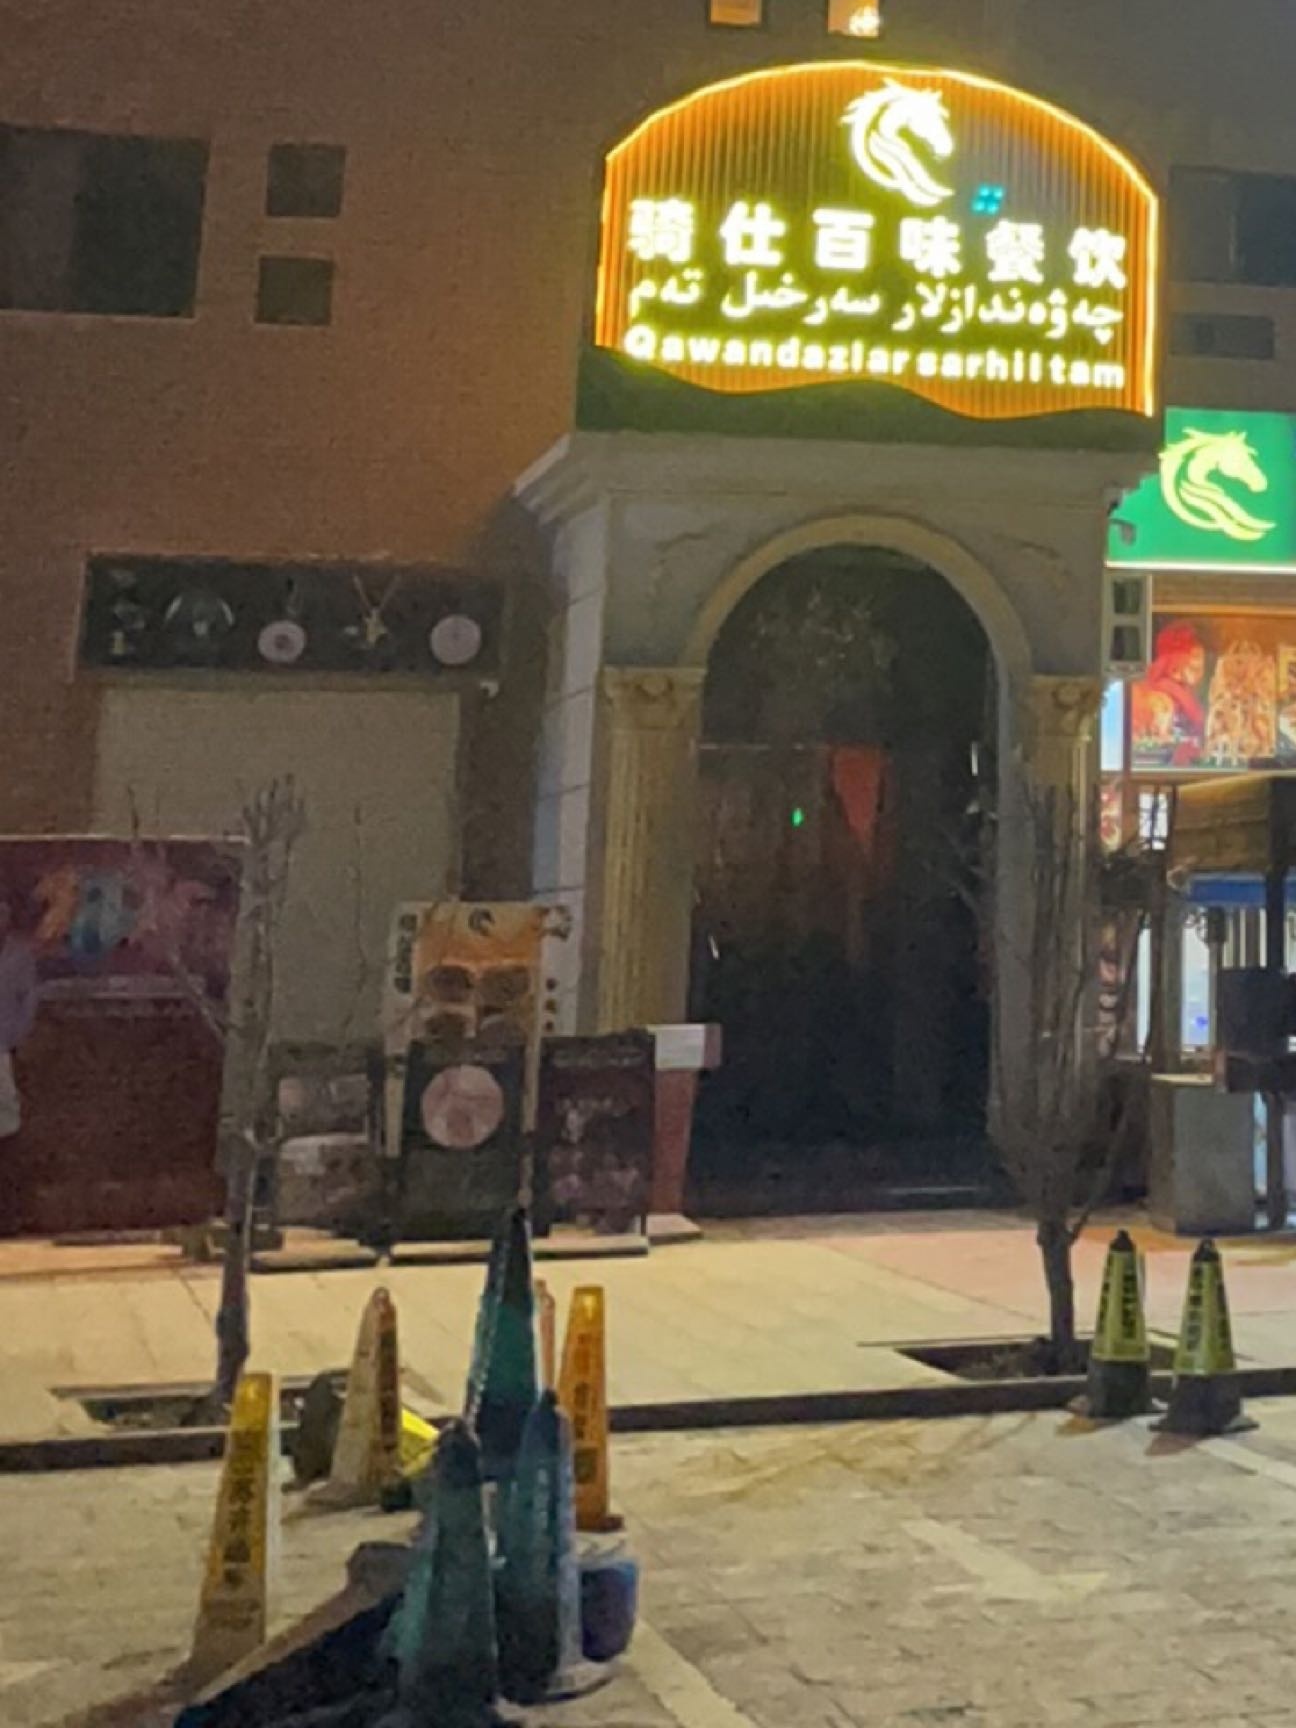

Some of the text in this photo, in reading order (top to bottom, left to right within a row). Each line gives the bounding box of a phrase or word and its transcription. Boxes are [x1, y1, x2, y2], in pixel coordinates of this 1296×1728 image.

[628, 198, 1128, 289] 骑仕百味餐饮
